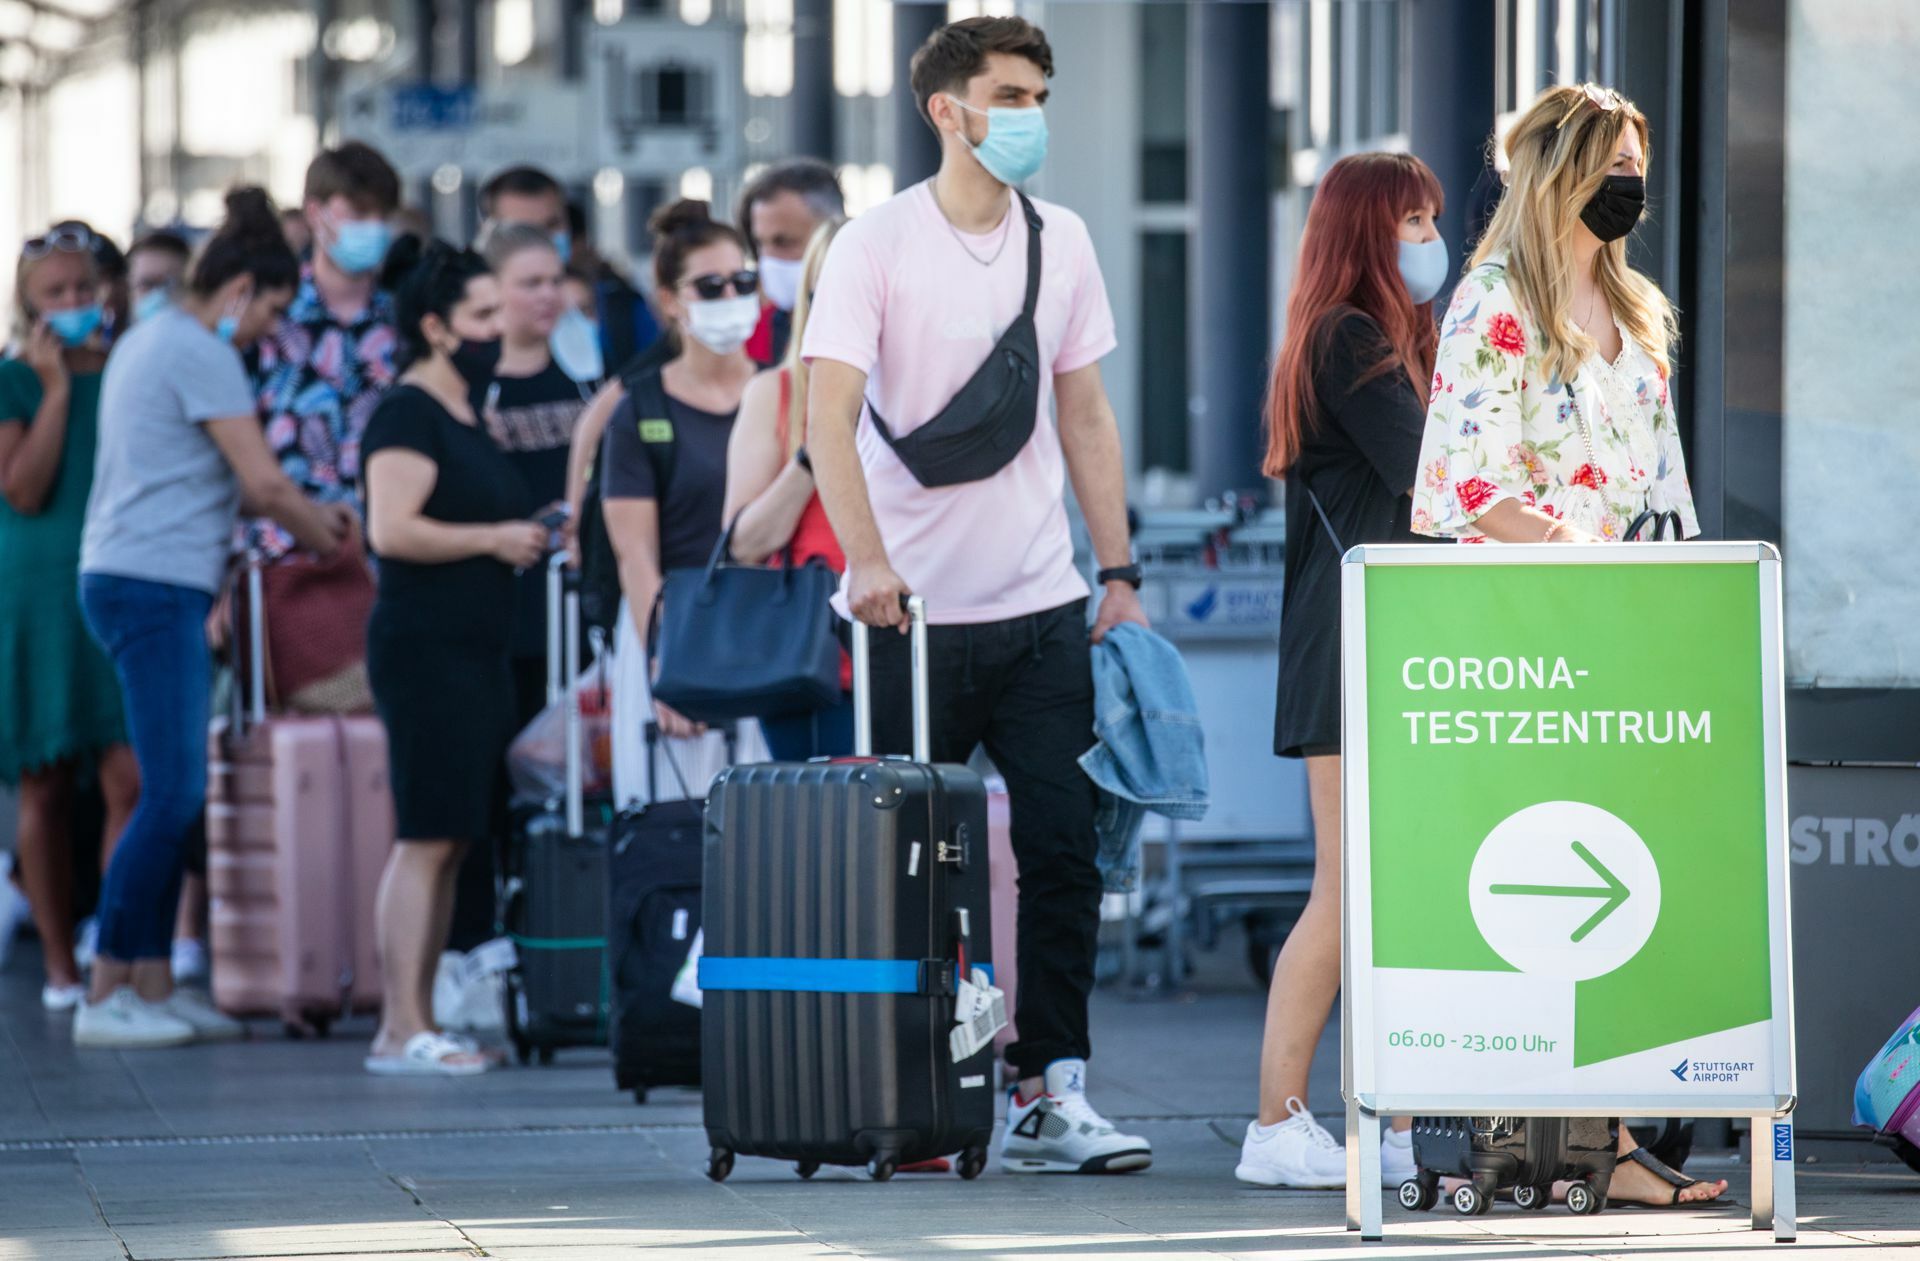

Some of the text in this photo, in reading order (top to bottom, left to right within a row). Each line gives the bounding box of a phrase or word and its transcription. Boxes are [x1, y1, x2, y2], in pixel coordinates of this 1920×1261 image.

[1402, 656, 1589, 690] CORONA-
[1402, 711, 1712, 744] TESTZENTRUM
[1388, 1029, 1446, 1048] 06.00
[1462, 1034, 1517, 1052] 23.00
[1522, 1034, 1557, 1053] Uhr
[1692, 1062, 1755, 1072] STUTTGART
[1692, 1073, 1740, 1082] AIRPORT
[1776, 1125, 1790, 1159] NKM
